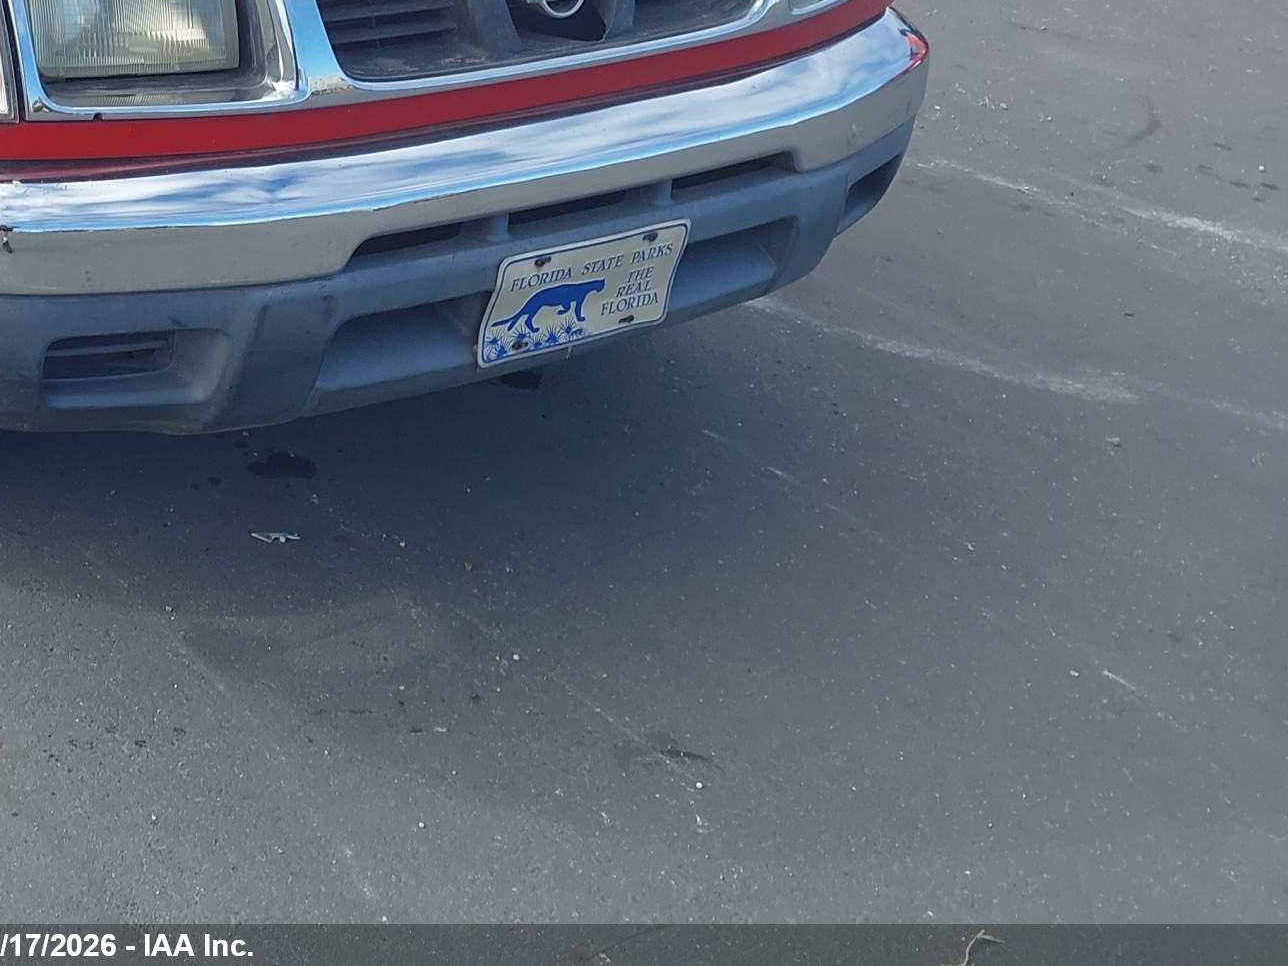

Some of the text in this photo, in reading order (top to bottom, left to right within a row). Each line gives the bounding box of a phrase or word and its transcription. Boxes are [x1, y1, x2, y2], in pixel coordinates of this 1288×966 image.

[510, 242, 673, 291] FLORIDA STATE PARKS
[626, 266, 654, 283] THE
[616, 279, 652, 298] REAL
[600, 292, 659, 316] FLORIDA
